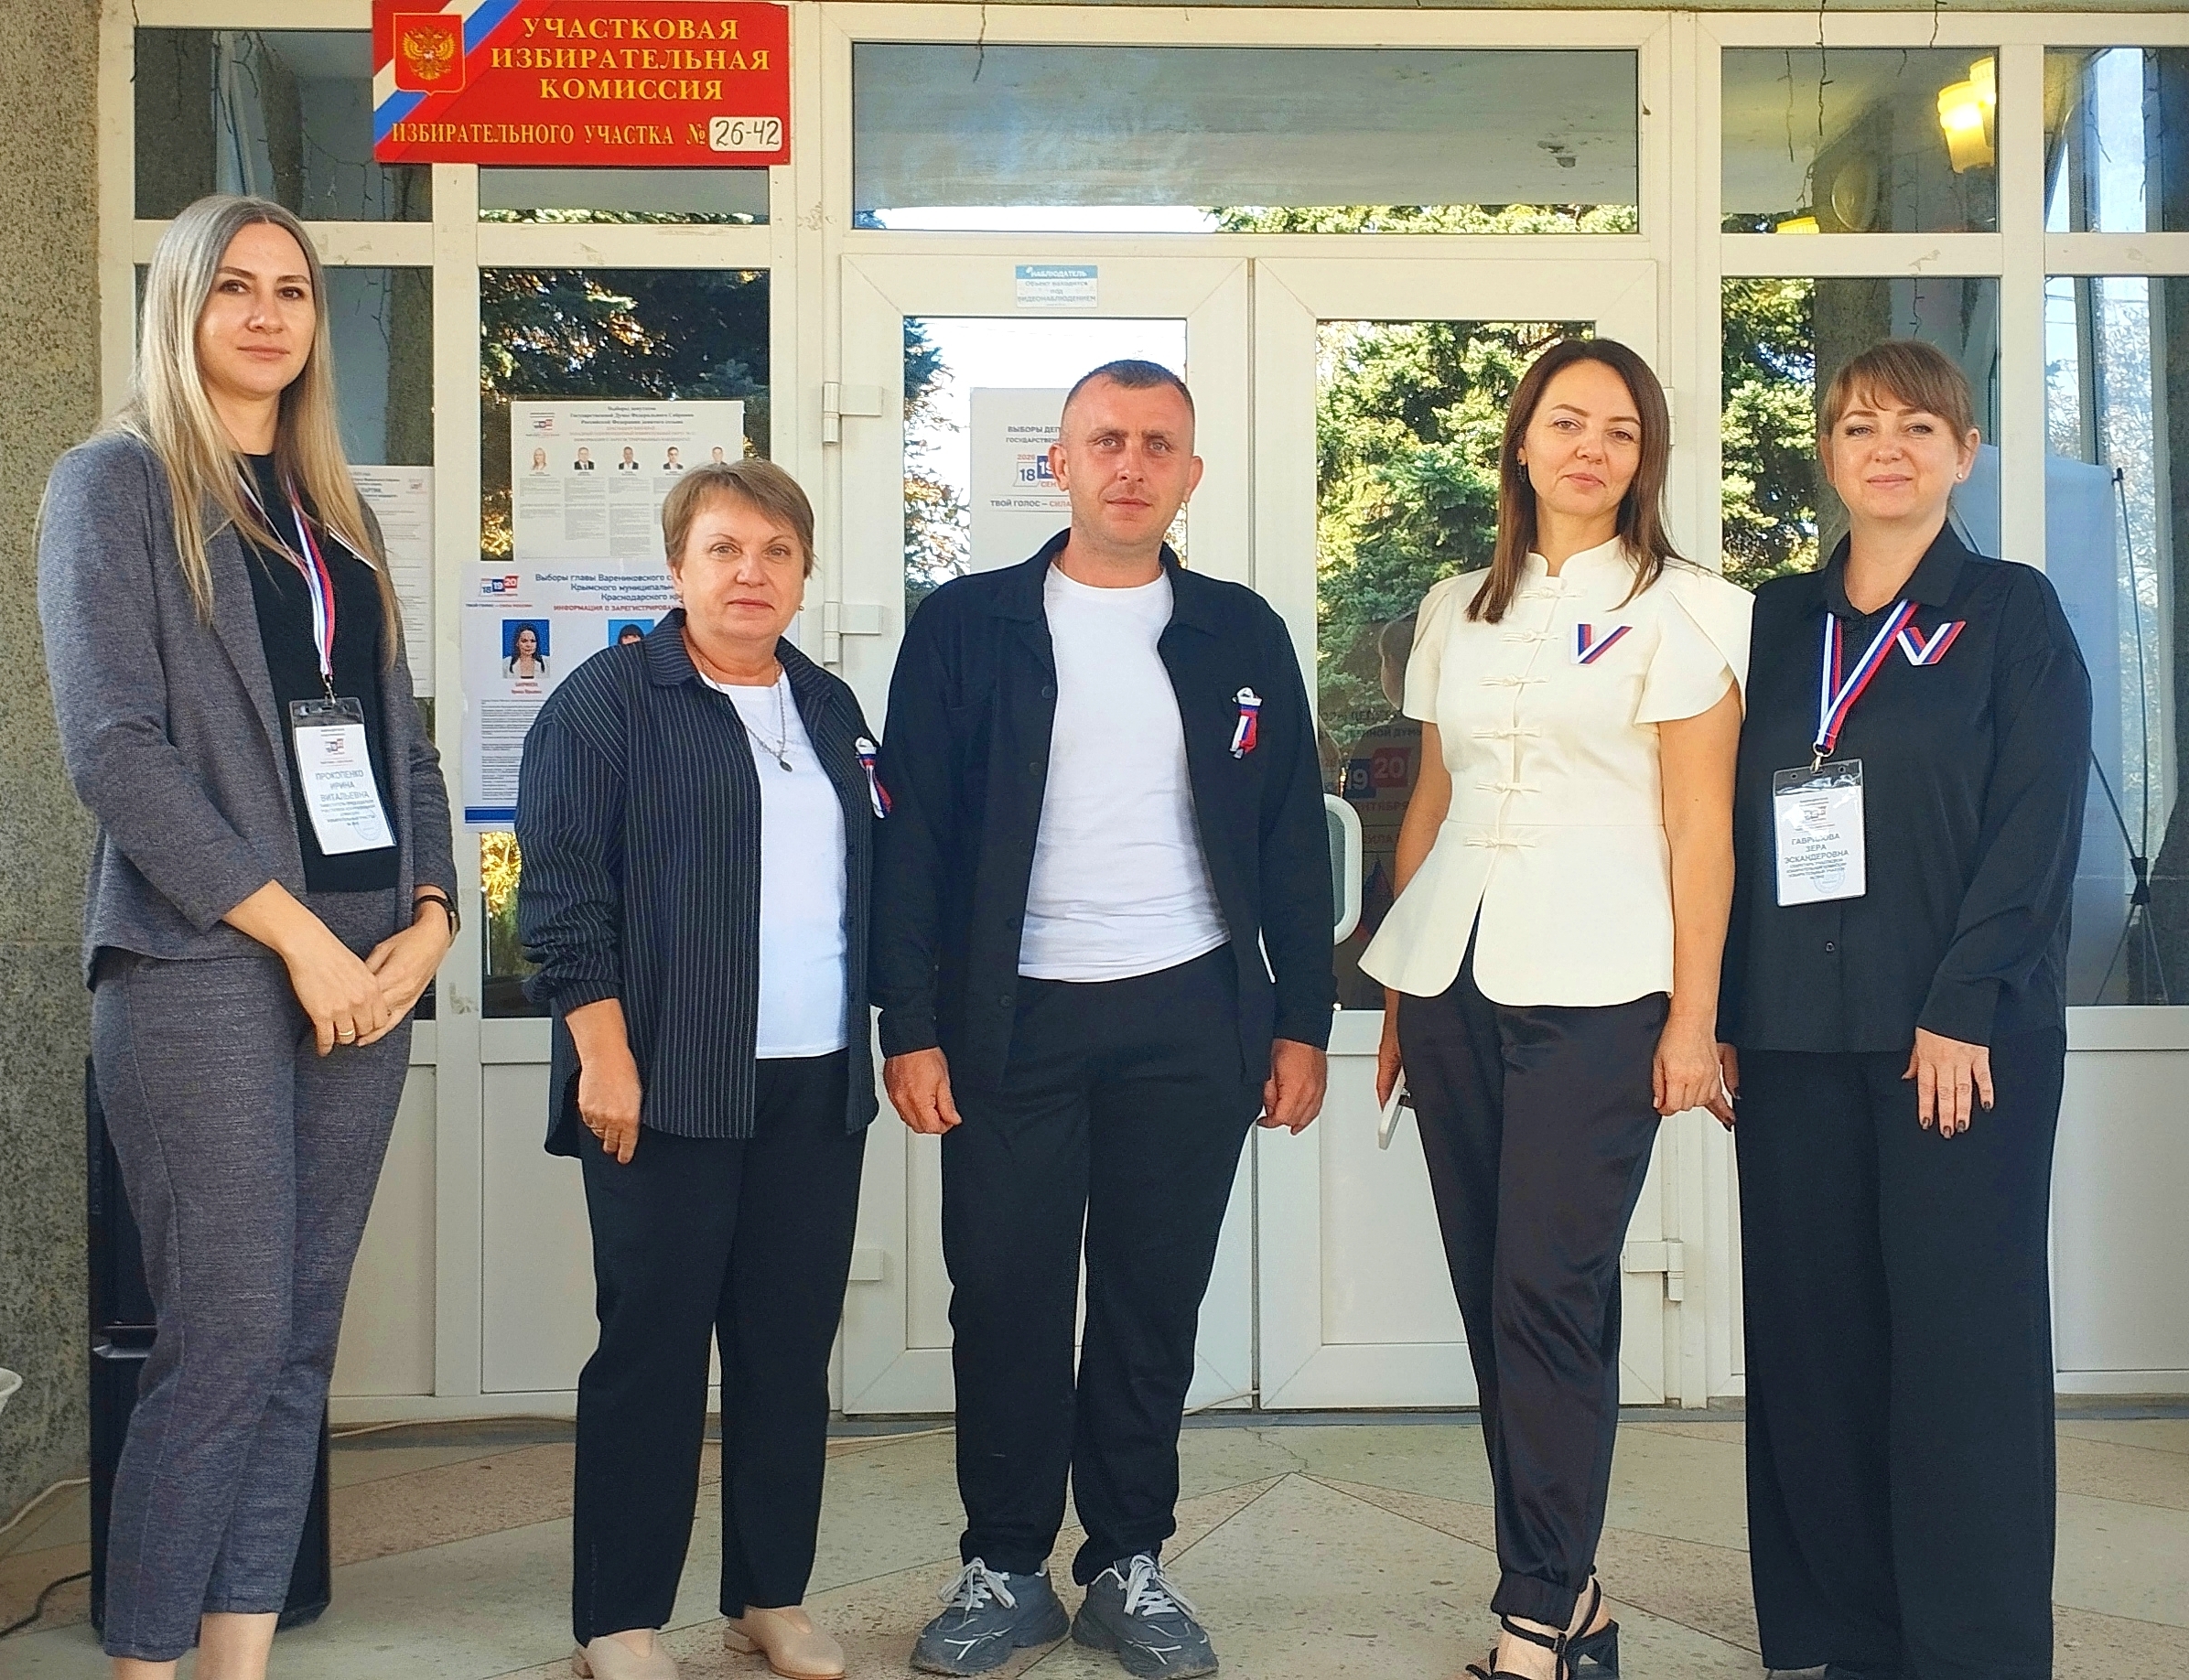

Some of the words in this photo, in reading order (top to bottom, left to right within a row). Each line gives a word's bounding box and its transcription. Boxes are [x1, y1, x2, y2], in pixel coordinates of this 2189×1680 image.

[522, 17, 739, 40] УЧАСТКОВАЯ
[491, 48, 770, 71] ИЗБИРАТЕЛЬНАЯ
[540, 79, 723, 101] КОМИССИЯ
[392, 123, 575, 145] ИЗБИРАТЕЛЬНОГО
[584, 124, 674, 145] УЧАСТКА
[715, 120, 780, 146] 26-42
[1019, 468, 1036, 481] 18
[990, 499, 1012, 507] ТВОЙ
[504, 578, 517, 587] 20
[535, 574, 568, 582] Выборы
[1374, 757, 1407, 779] 20
